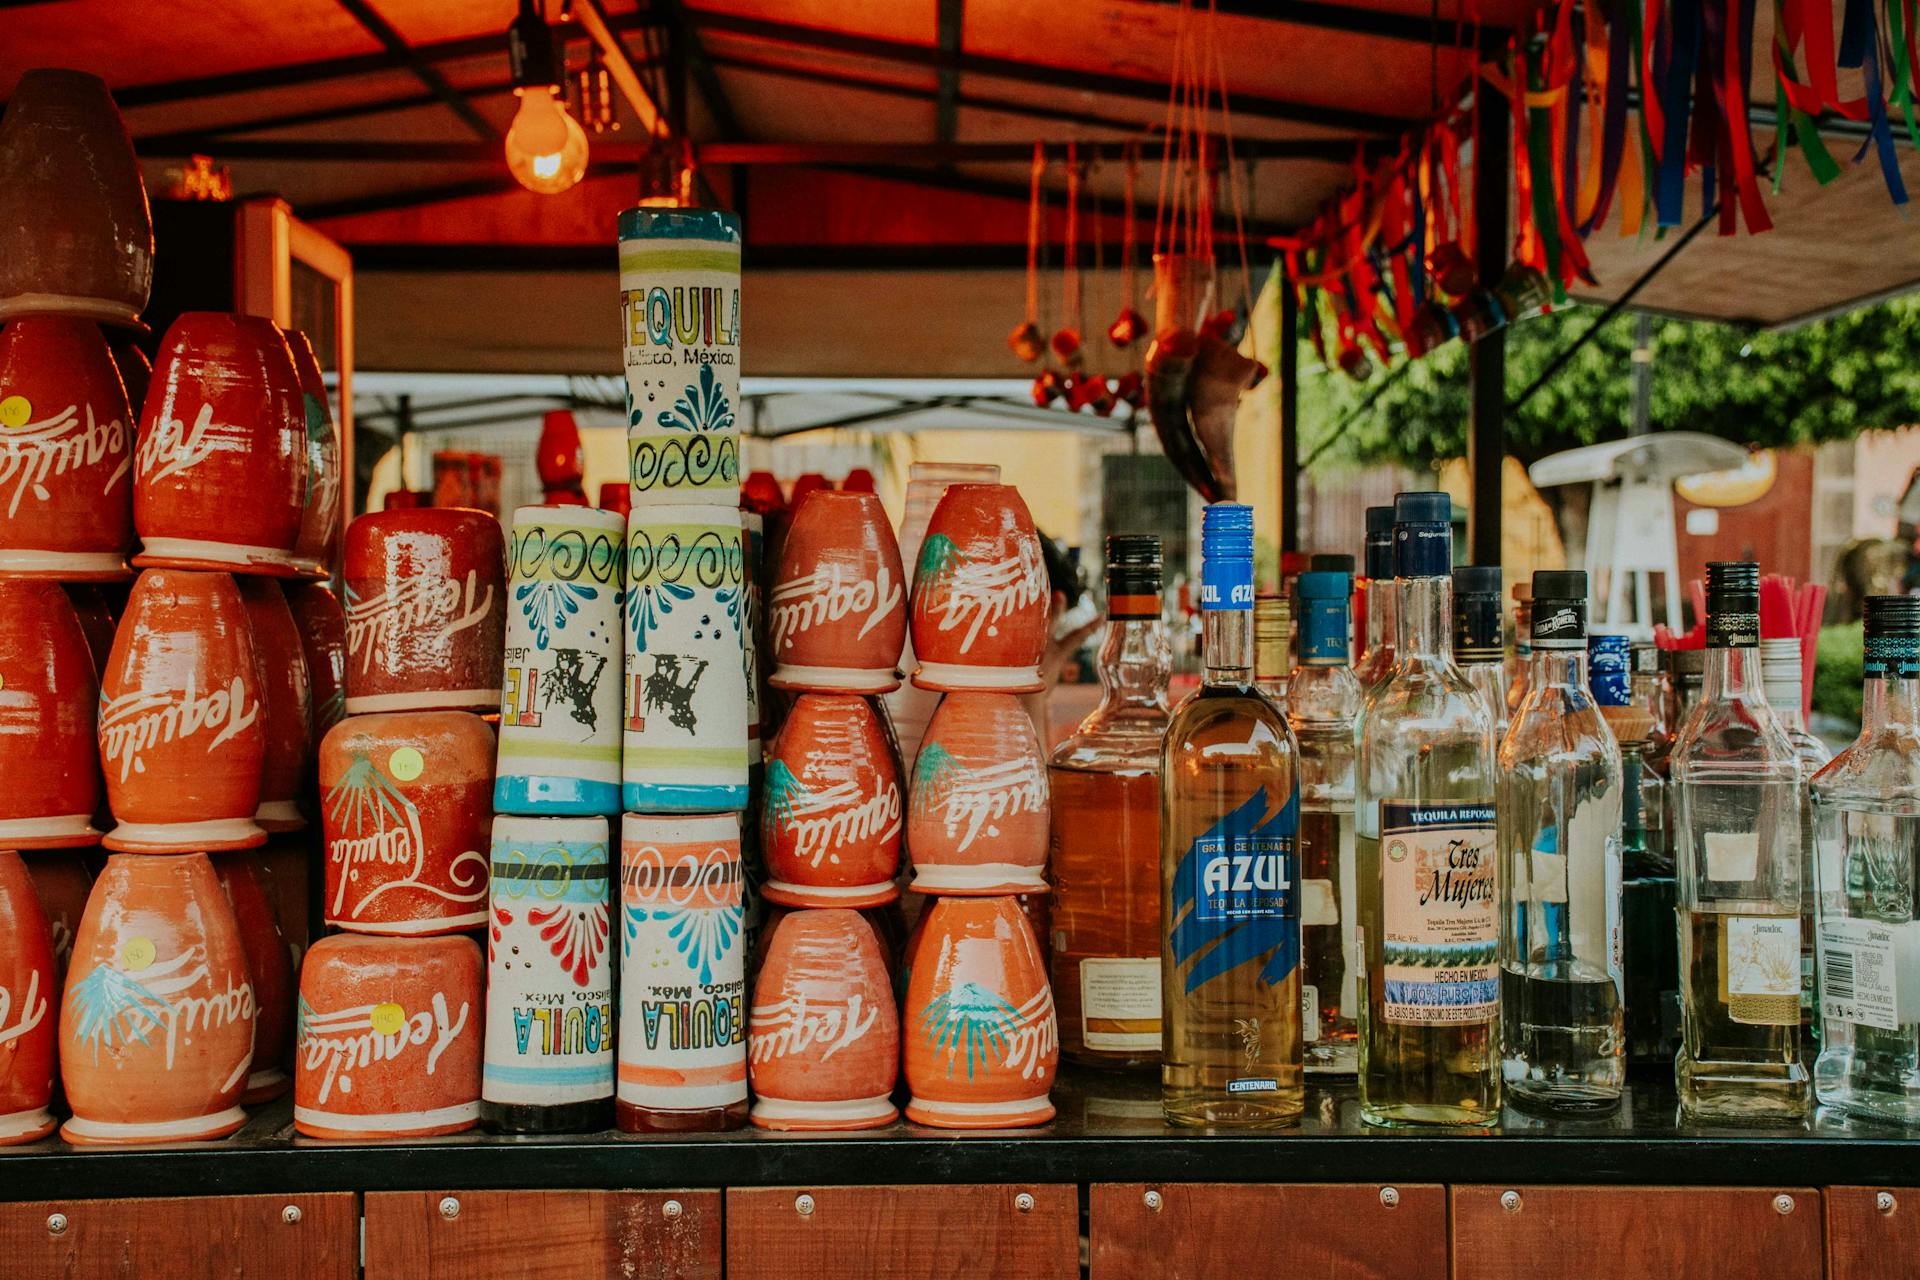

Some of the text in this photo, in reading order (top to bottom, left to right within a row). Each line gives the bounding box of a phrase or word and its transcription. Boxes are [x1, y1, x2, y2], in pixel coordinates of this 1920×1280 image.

[620, 286, 740, 349] TEQUILA
[101, 670, 260, 784] Tequila
[1410, 810, 1457, 822] TEQUILA
[331, 799, 489, 918] Tequila
[1202, 843, 1230, 853] GRA
[1448, 839, 1479, 869] Tres
[1203, 855, 1291, 896] AZUL
[1420, 870, 1494, 909] Mujeres
[1405, 987, 1437, 1000] 100%
[1441, 987, 1470, 1000] PURO
[1434, 971, 1459, 983] HECHO
[1460, 970, 1468, 982] EN
[513, 1002, 613, 1055] EQUILA
[642, 994, 747, 1050] EQUILA
[305, 992, 469, 1104] Tequila
[1229, 1080, 1278, 1091] CENTENARIO
